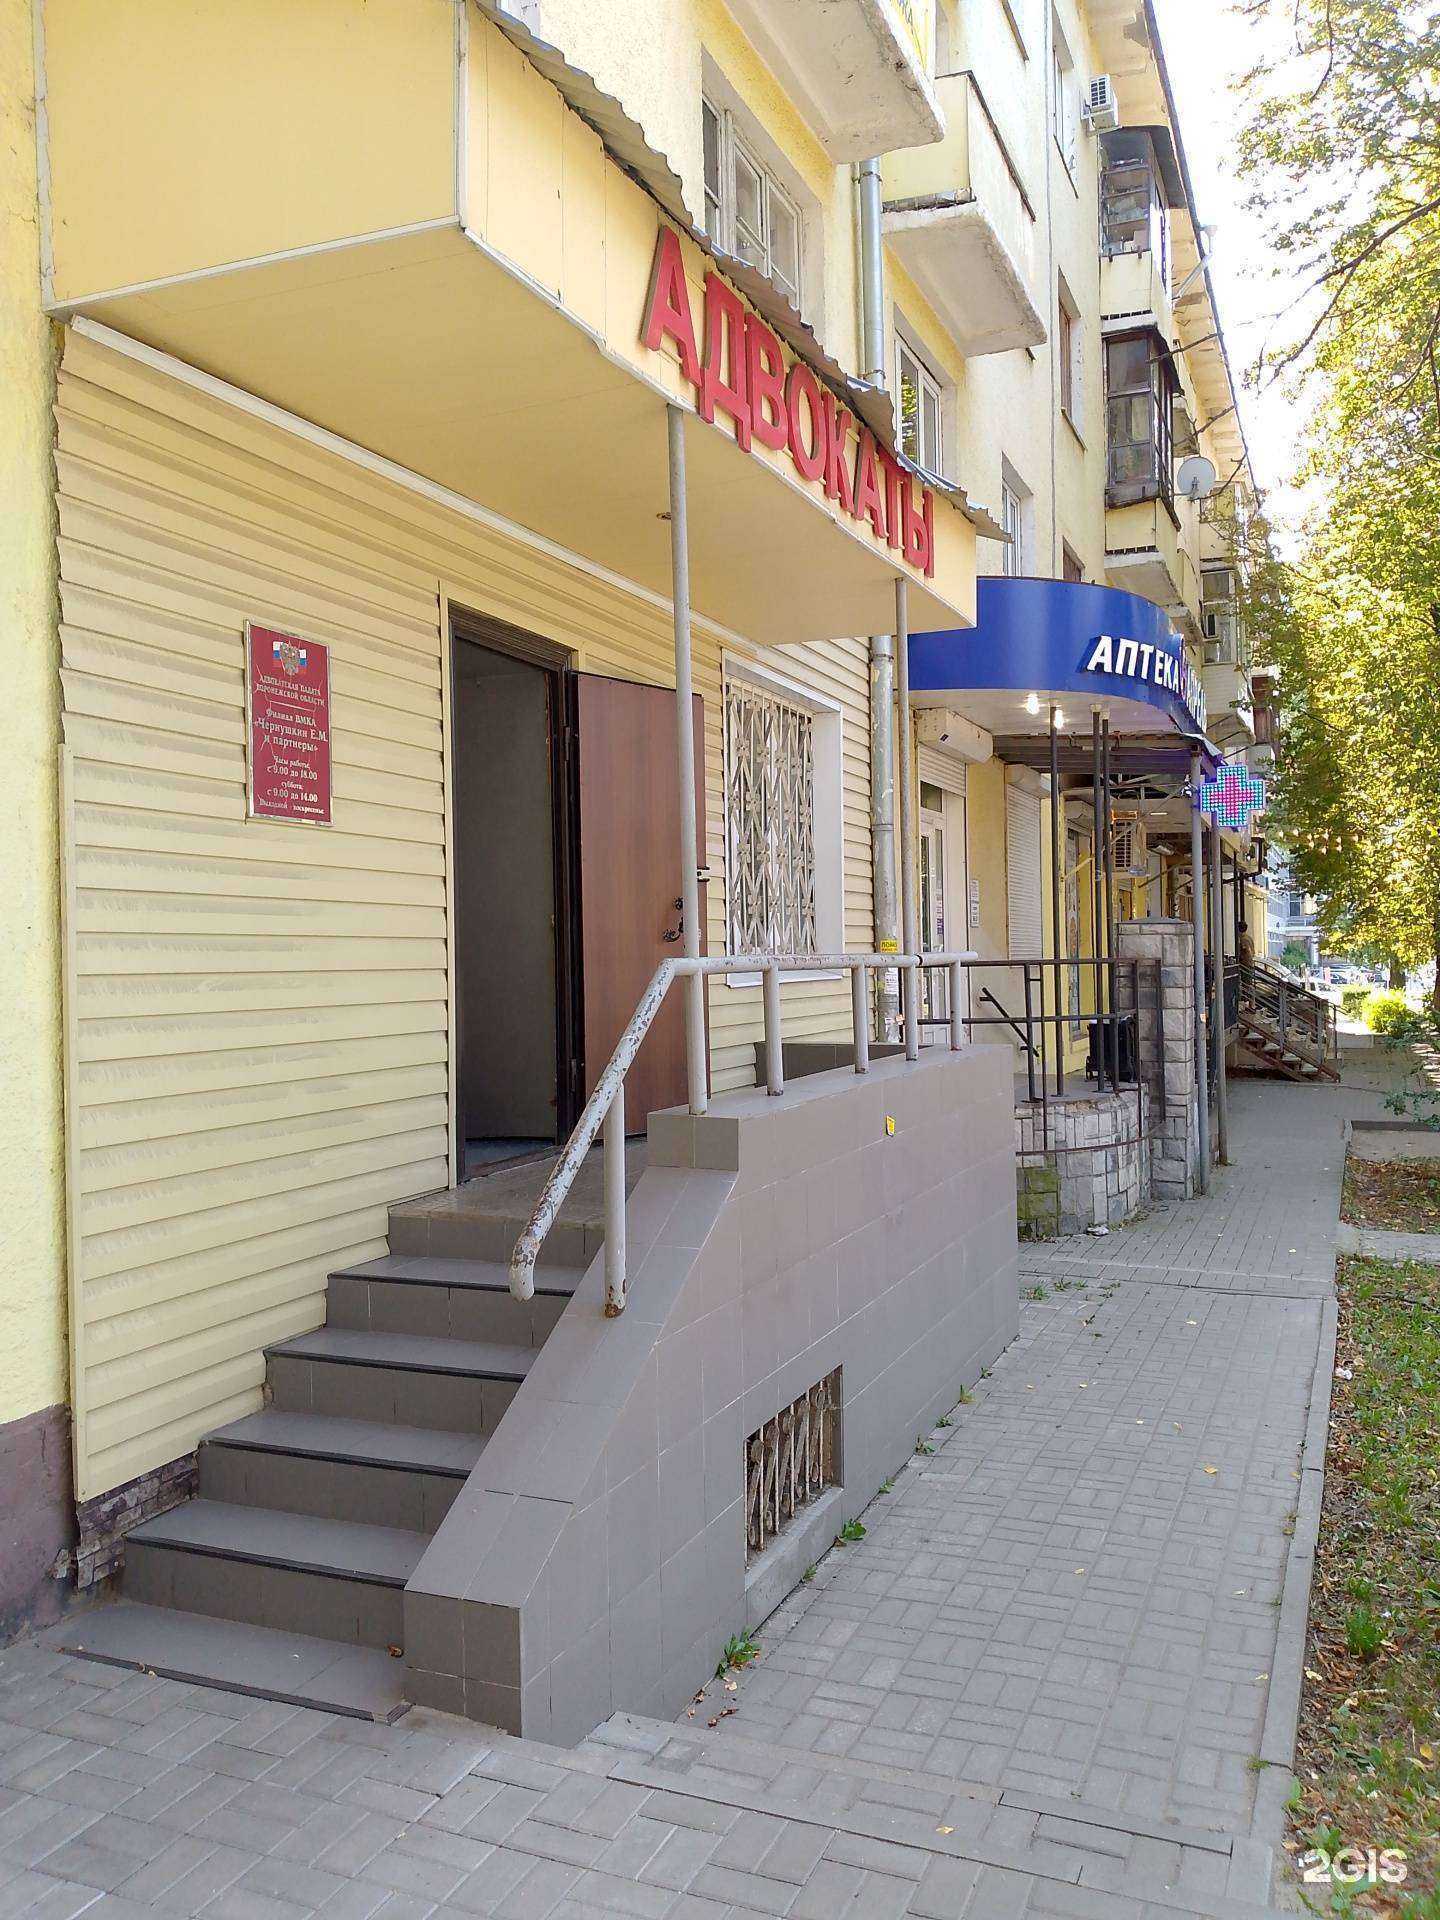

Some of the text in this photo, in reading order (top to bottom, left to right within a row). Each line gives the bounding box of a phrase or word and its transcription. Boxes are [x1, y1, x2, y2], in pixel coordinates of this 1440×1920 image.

[641, 225, 934, 578] АДВОКАТЫ
[1085, 635, 1180, 694] АПТЕКА
[273, 765, 289, 776] 9.00
[273, 787, 289, 798] 9.00
[290, 792, 299, 800] до
[300, 792, 318, 803] 14.00
